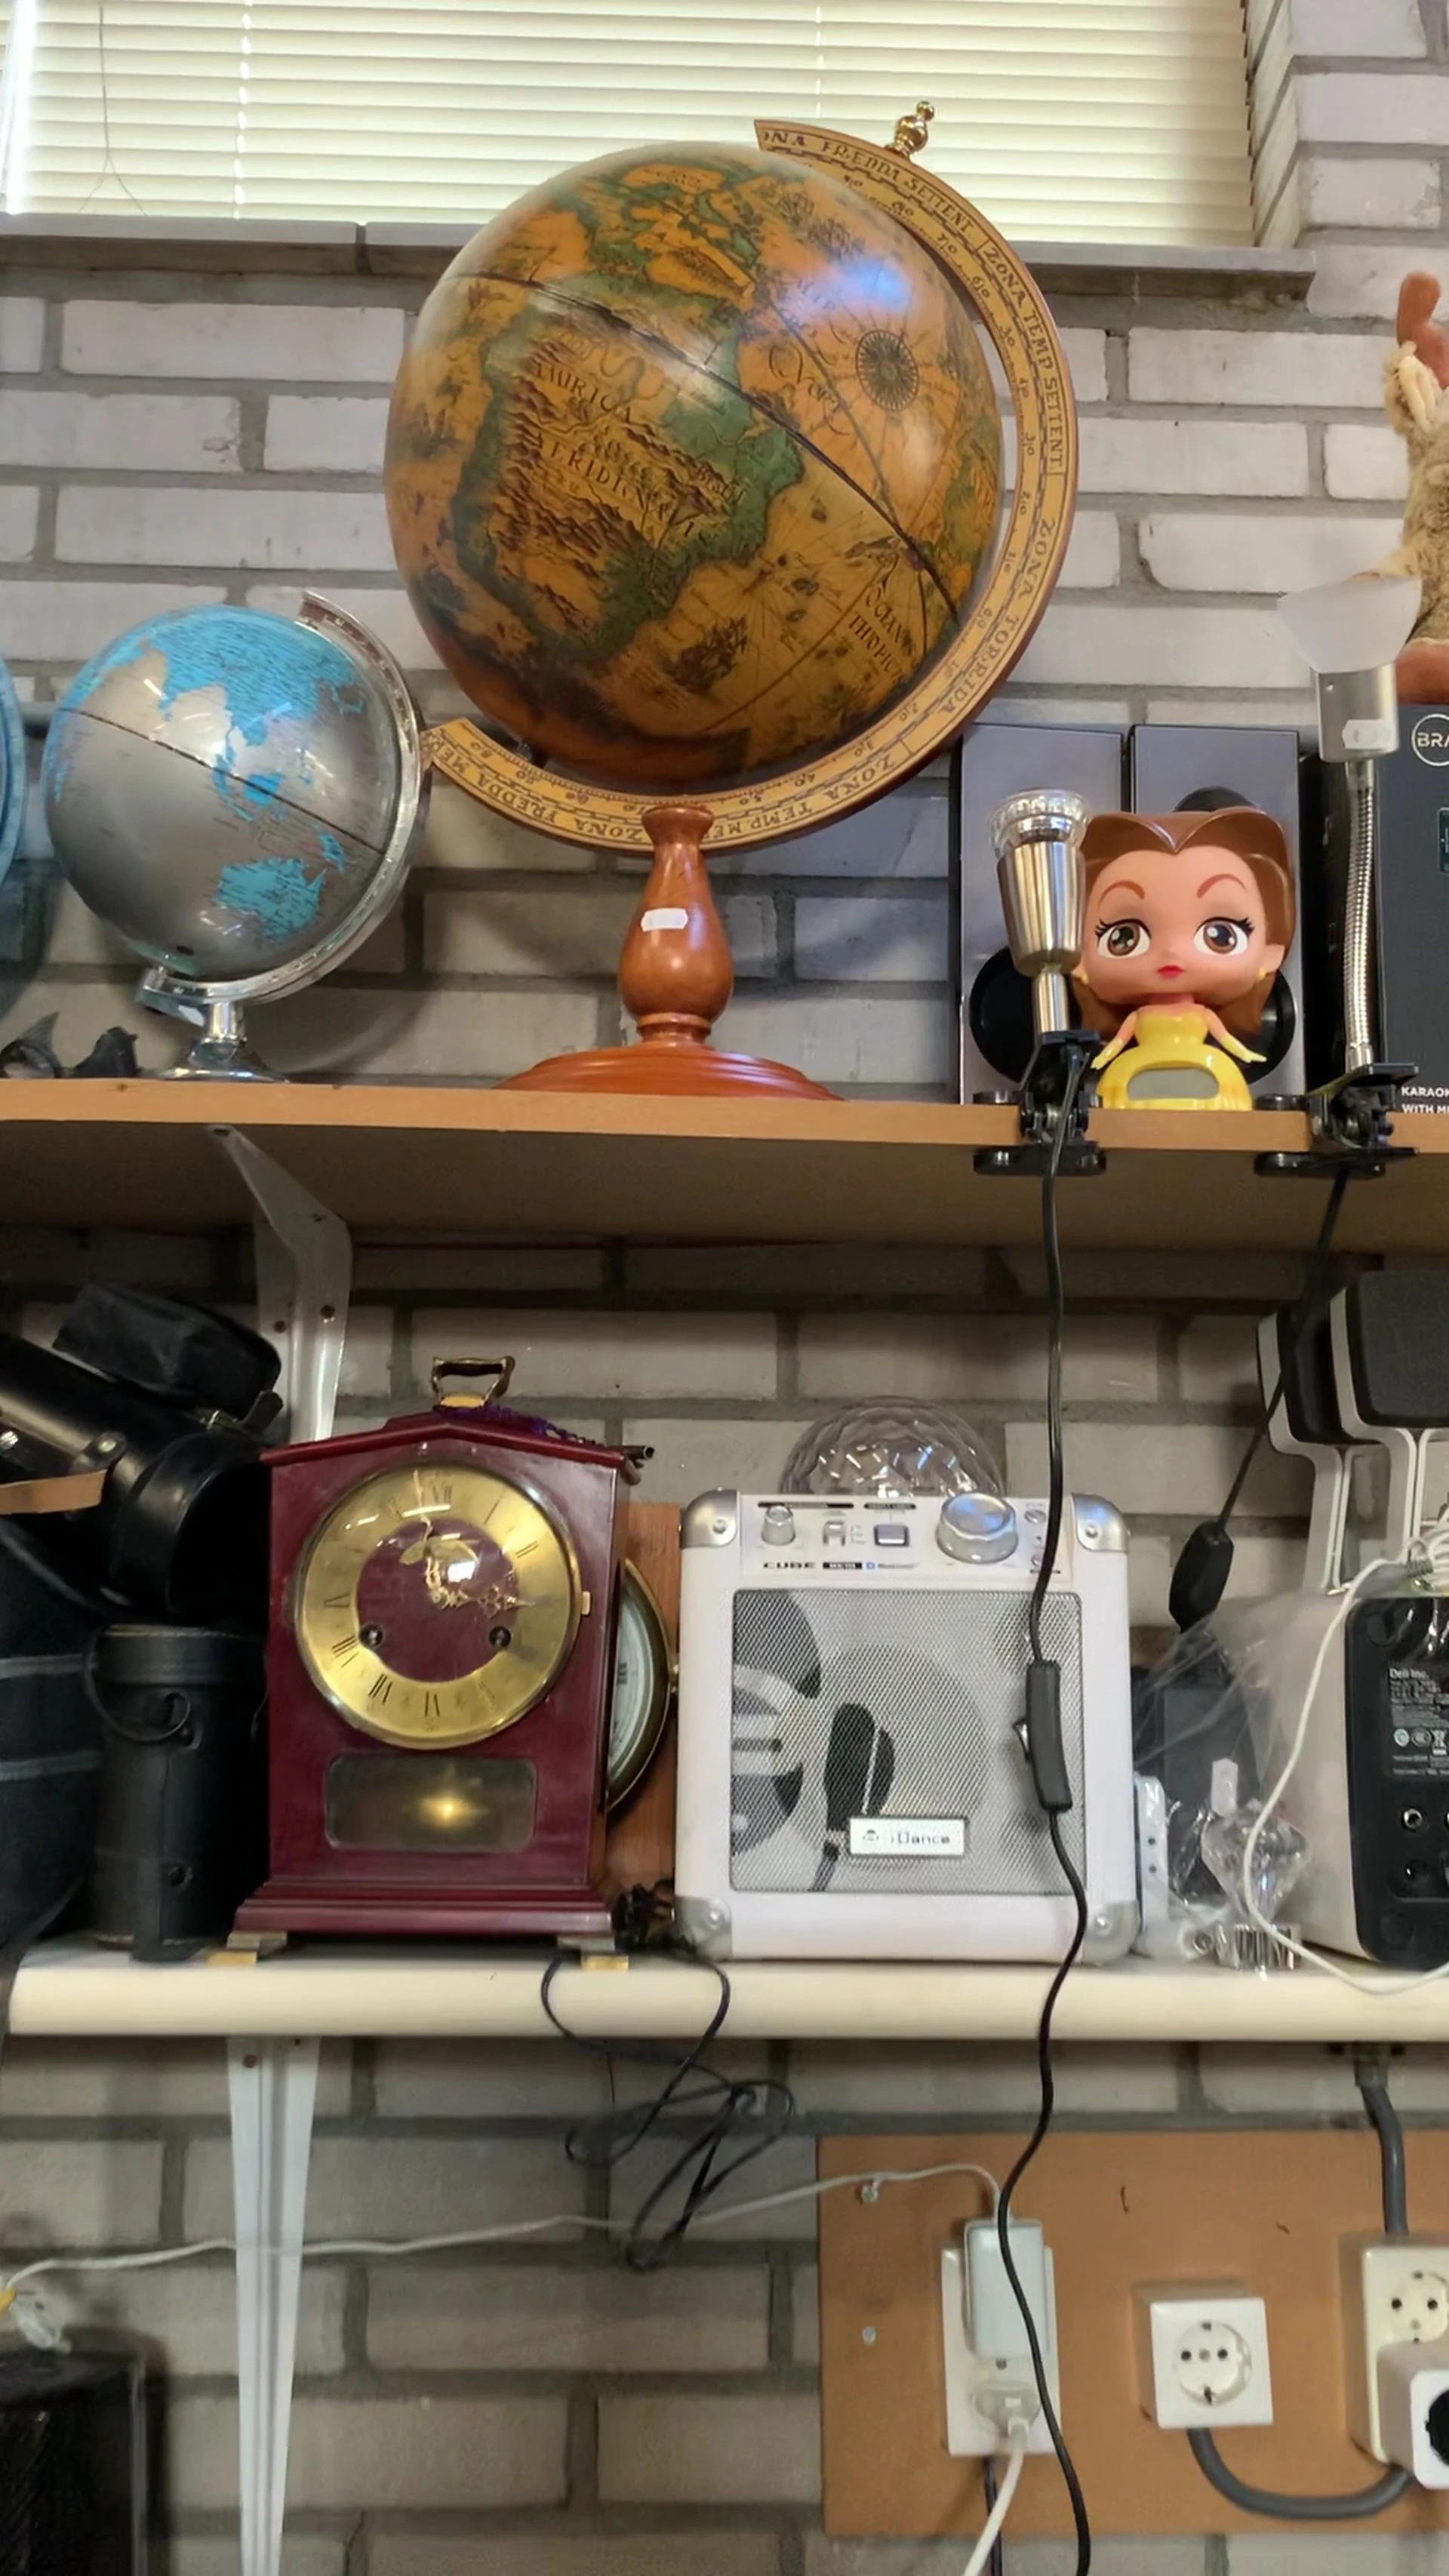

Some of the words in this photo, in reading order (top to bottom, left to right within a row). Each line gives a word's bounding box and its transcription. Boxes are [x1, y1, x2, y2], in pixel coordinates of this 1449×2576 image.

[763, 131, 805, 147] NA
[983, 246, 1028, 309] ZONA
[1019, 516, 1056, 599] ZONA
[939, 616, 1019, 713] TORRIDA
[824, 754, 897, 802] ZONA
[478, 773, 558, 823] FREDDA
[574, 817, 644, 841] ZONA
[703, 821, 742, 839] ME
[1401, 1103, 1434, 1114] WITH
[1389, 1667, 1409, 1679] Dell
